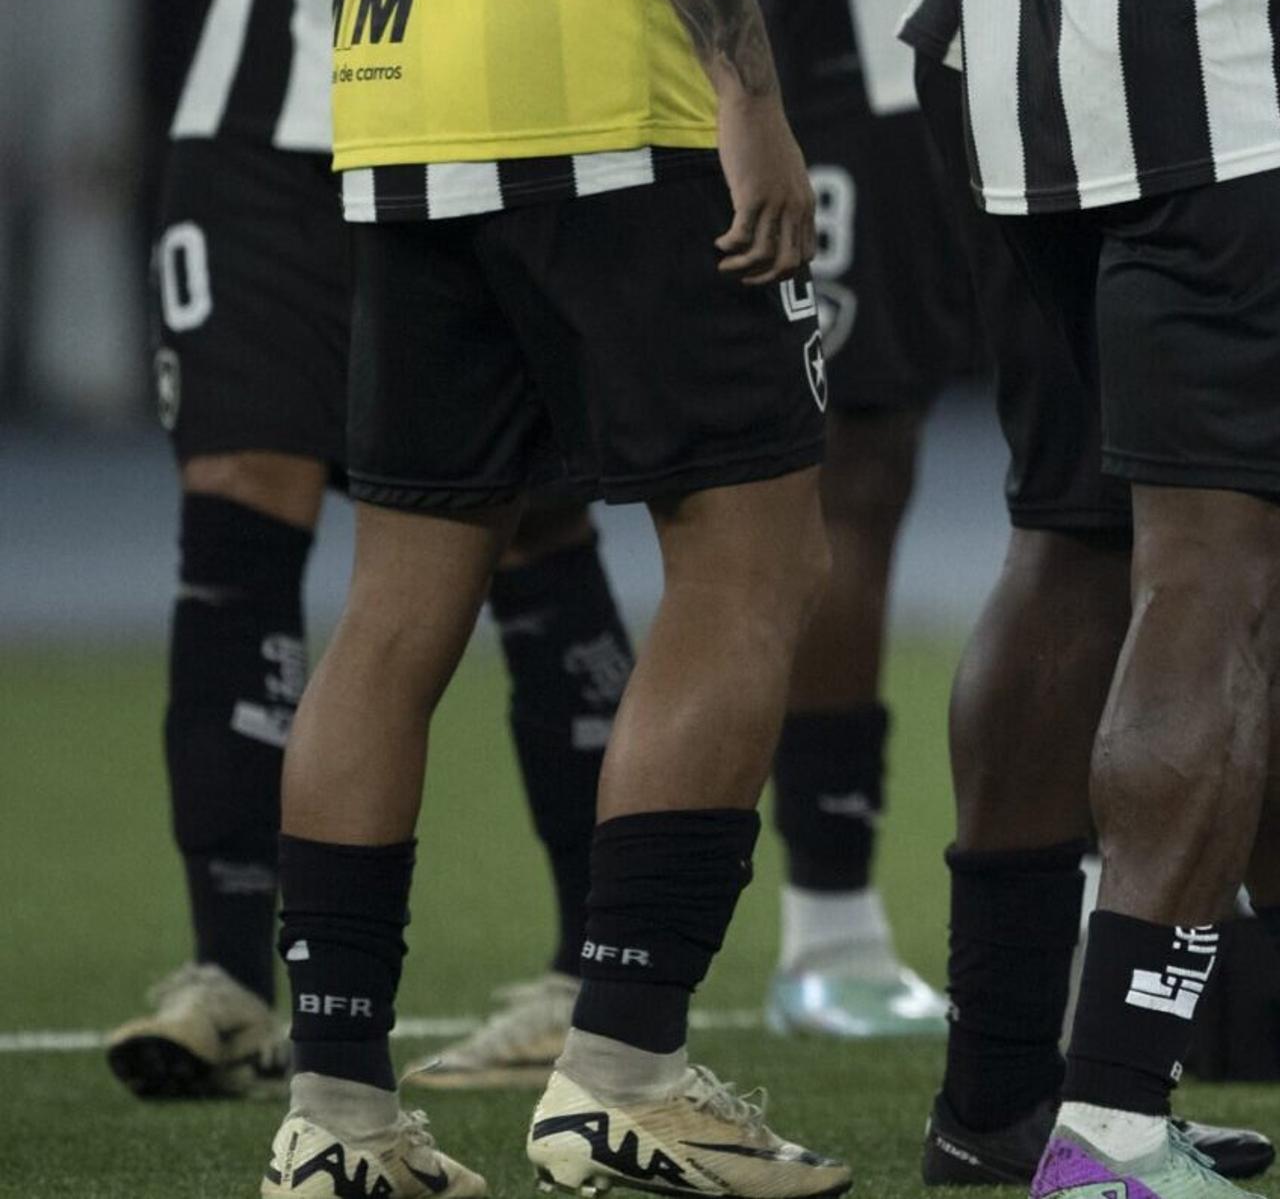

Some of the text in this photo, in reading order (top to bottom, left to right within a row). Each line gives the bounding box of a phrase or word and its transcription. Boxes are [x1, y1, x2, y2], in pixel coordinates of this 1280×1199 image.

[356, 65, 402, 82] carros
[581, 941, 650, 966] BFR
[299, 993, 373, 1018] BFR
